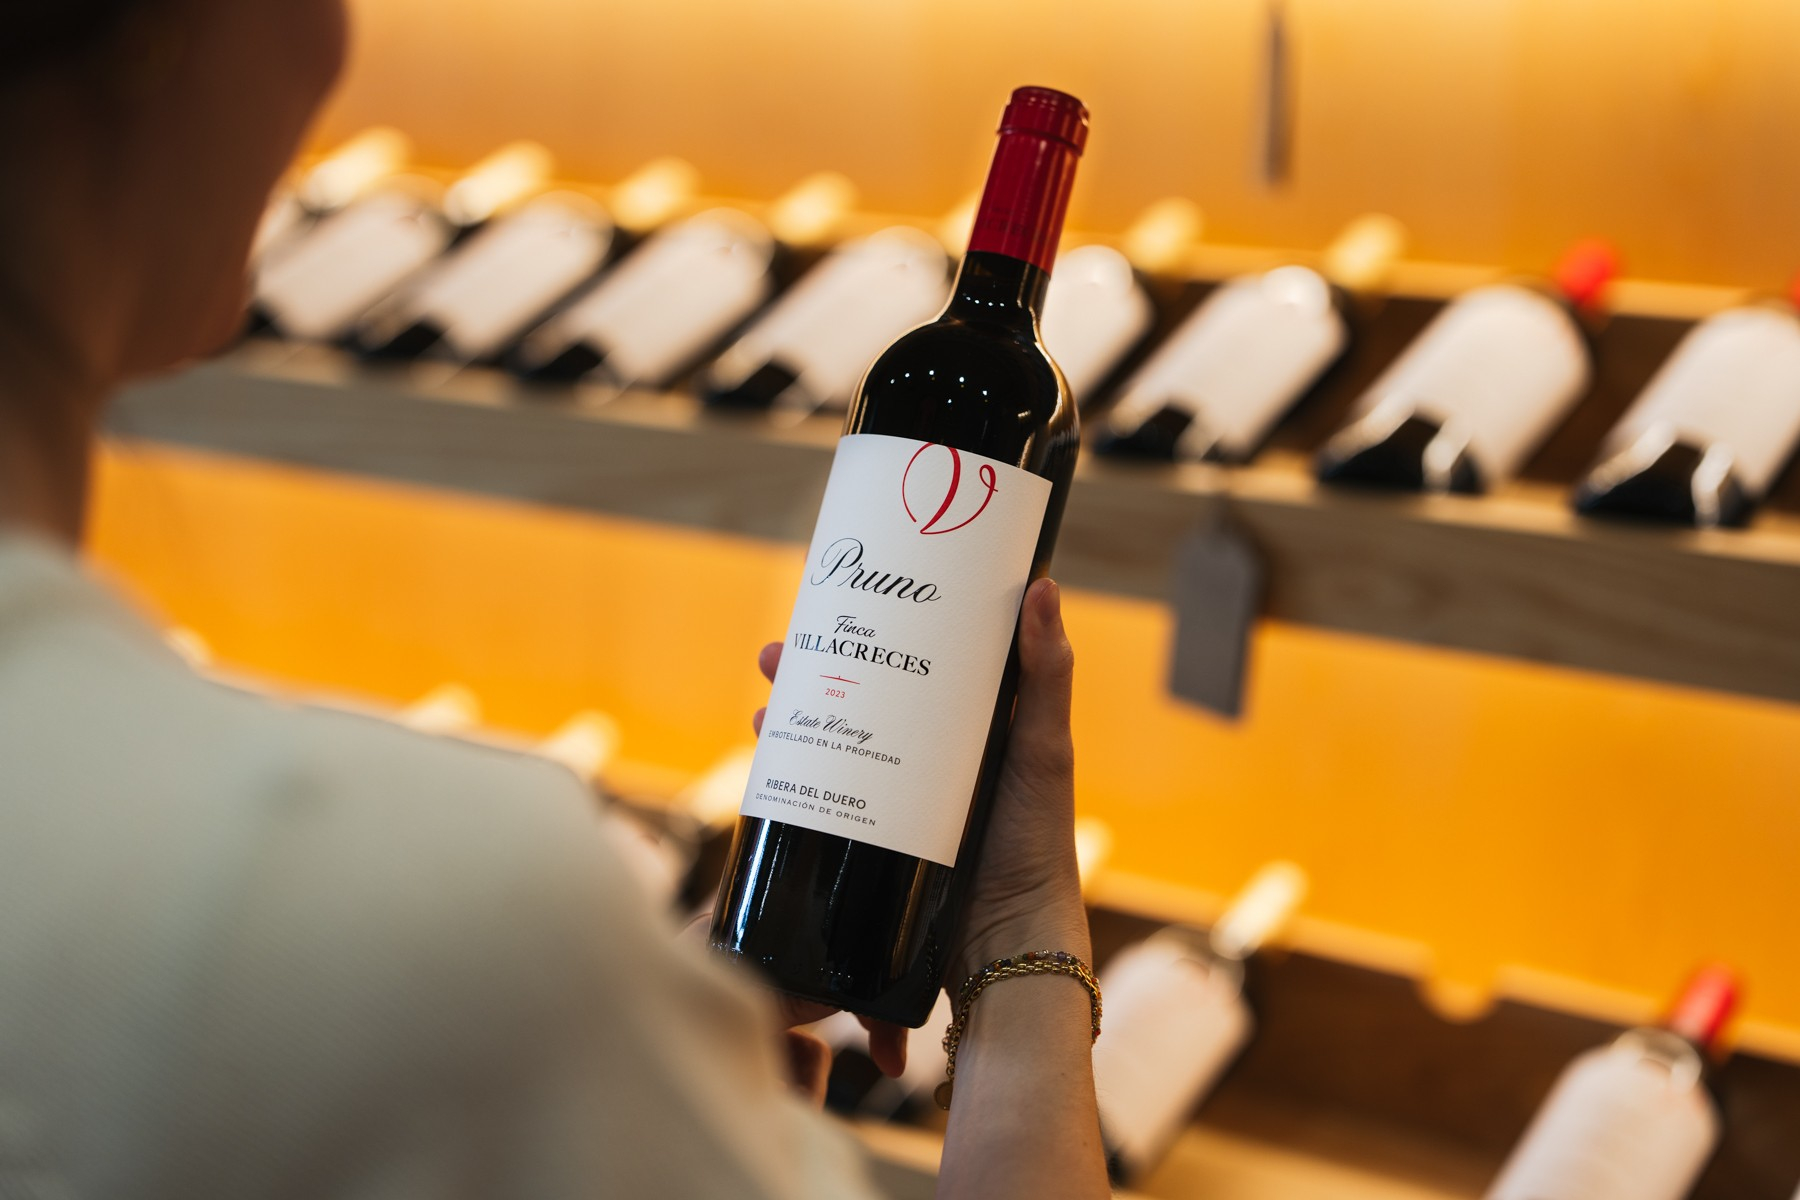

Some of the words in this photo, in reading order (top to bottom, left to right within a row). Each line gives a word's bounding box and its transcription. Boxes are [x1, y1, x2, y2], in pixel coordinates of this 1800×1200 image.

[811, 537, 942, 604] Pruno
[834, 615, 876, 639] Finca
[794, 632, 932, 676] VILLACRECES
[825, 688, 846, 699] 2023
[789, 709, 821, 729] Estate
[824, 714, 873, 744] Winery
[768, 730, 814, 745] EMBOTELLADO
[816, 738, 828, 747] EN
[831, 740, 842, 750] LA
[845, 745, 901, 766] PROPIEDAD
[755, 792, 815, 811] DENOMINACIÓN
[818, 807, 832, 815] DE
[836, 810, 876, 826] ORIGEN
[765, 778, 797, 794] RIBERA
[799, 784, 820, 798] DEL
[823, 790, 867, 810] DUERO
